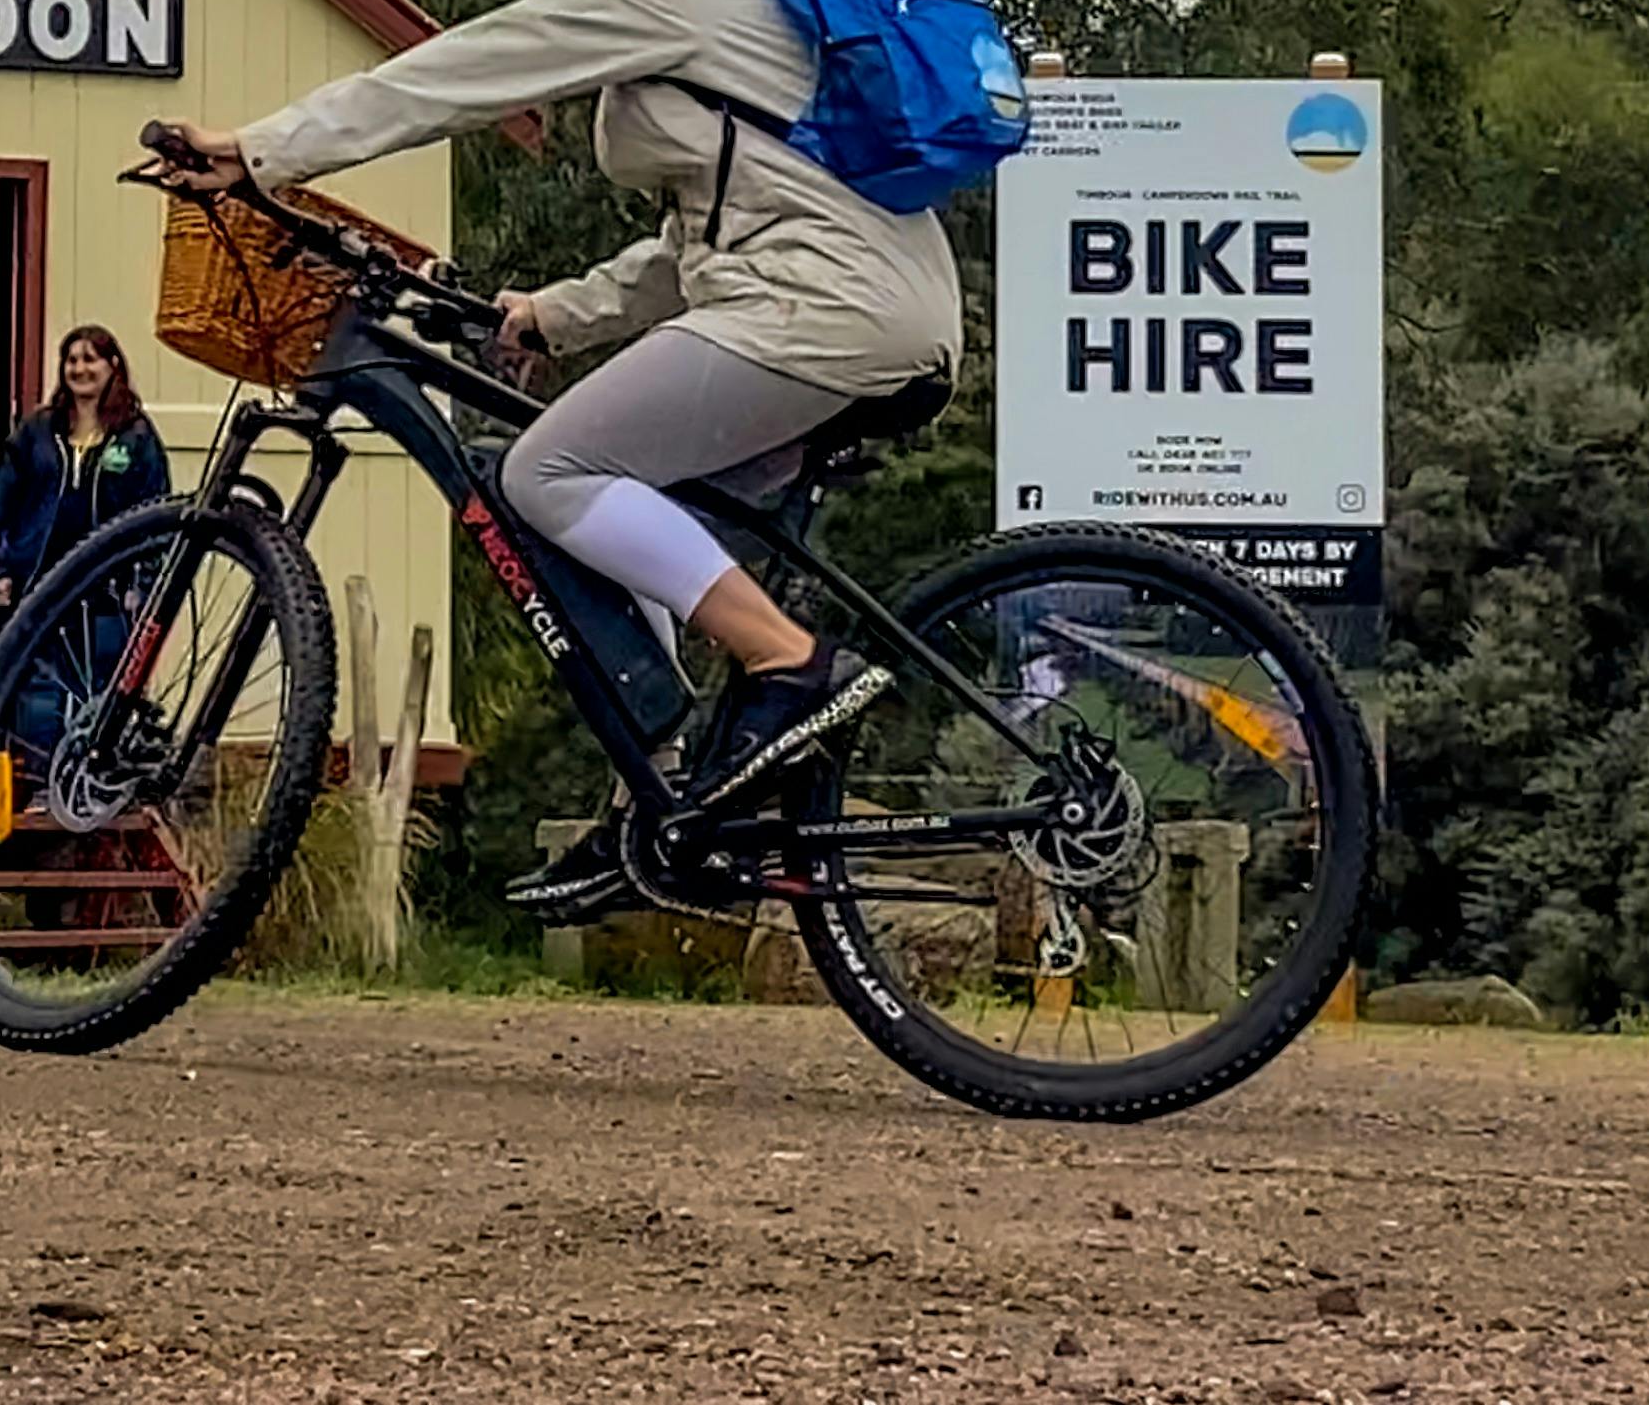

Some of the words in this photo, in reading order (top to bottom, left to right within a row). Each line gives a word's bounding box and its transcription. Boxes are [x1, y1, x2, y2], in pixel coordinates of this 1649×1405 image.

[1070, 219, 1311, 296] BIKE
[1066, 317, 1314, 394] HIRE
[1092, 490, 1288, 507] RIDEWITHUS.COM.AU
[1231, 539, 1249, 558] 7
[1255, 539, 1318, 558] DAYS
[1323, 539, 1358, 558] BY
